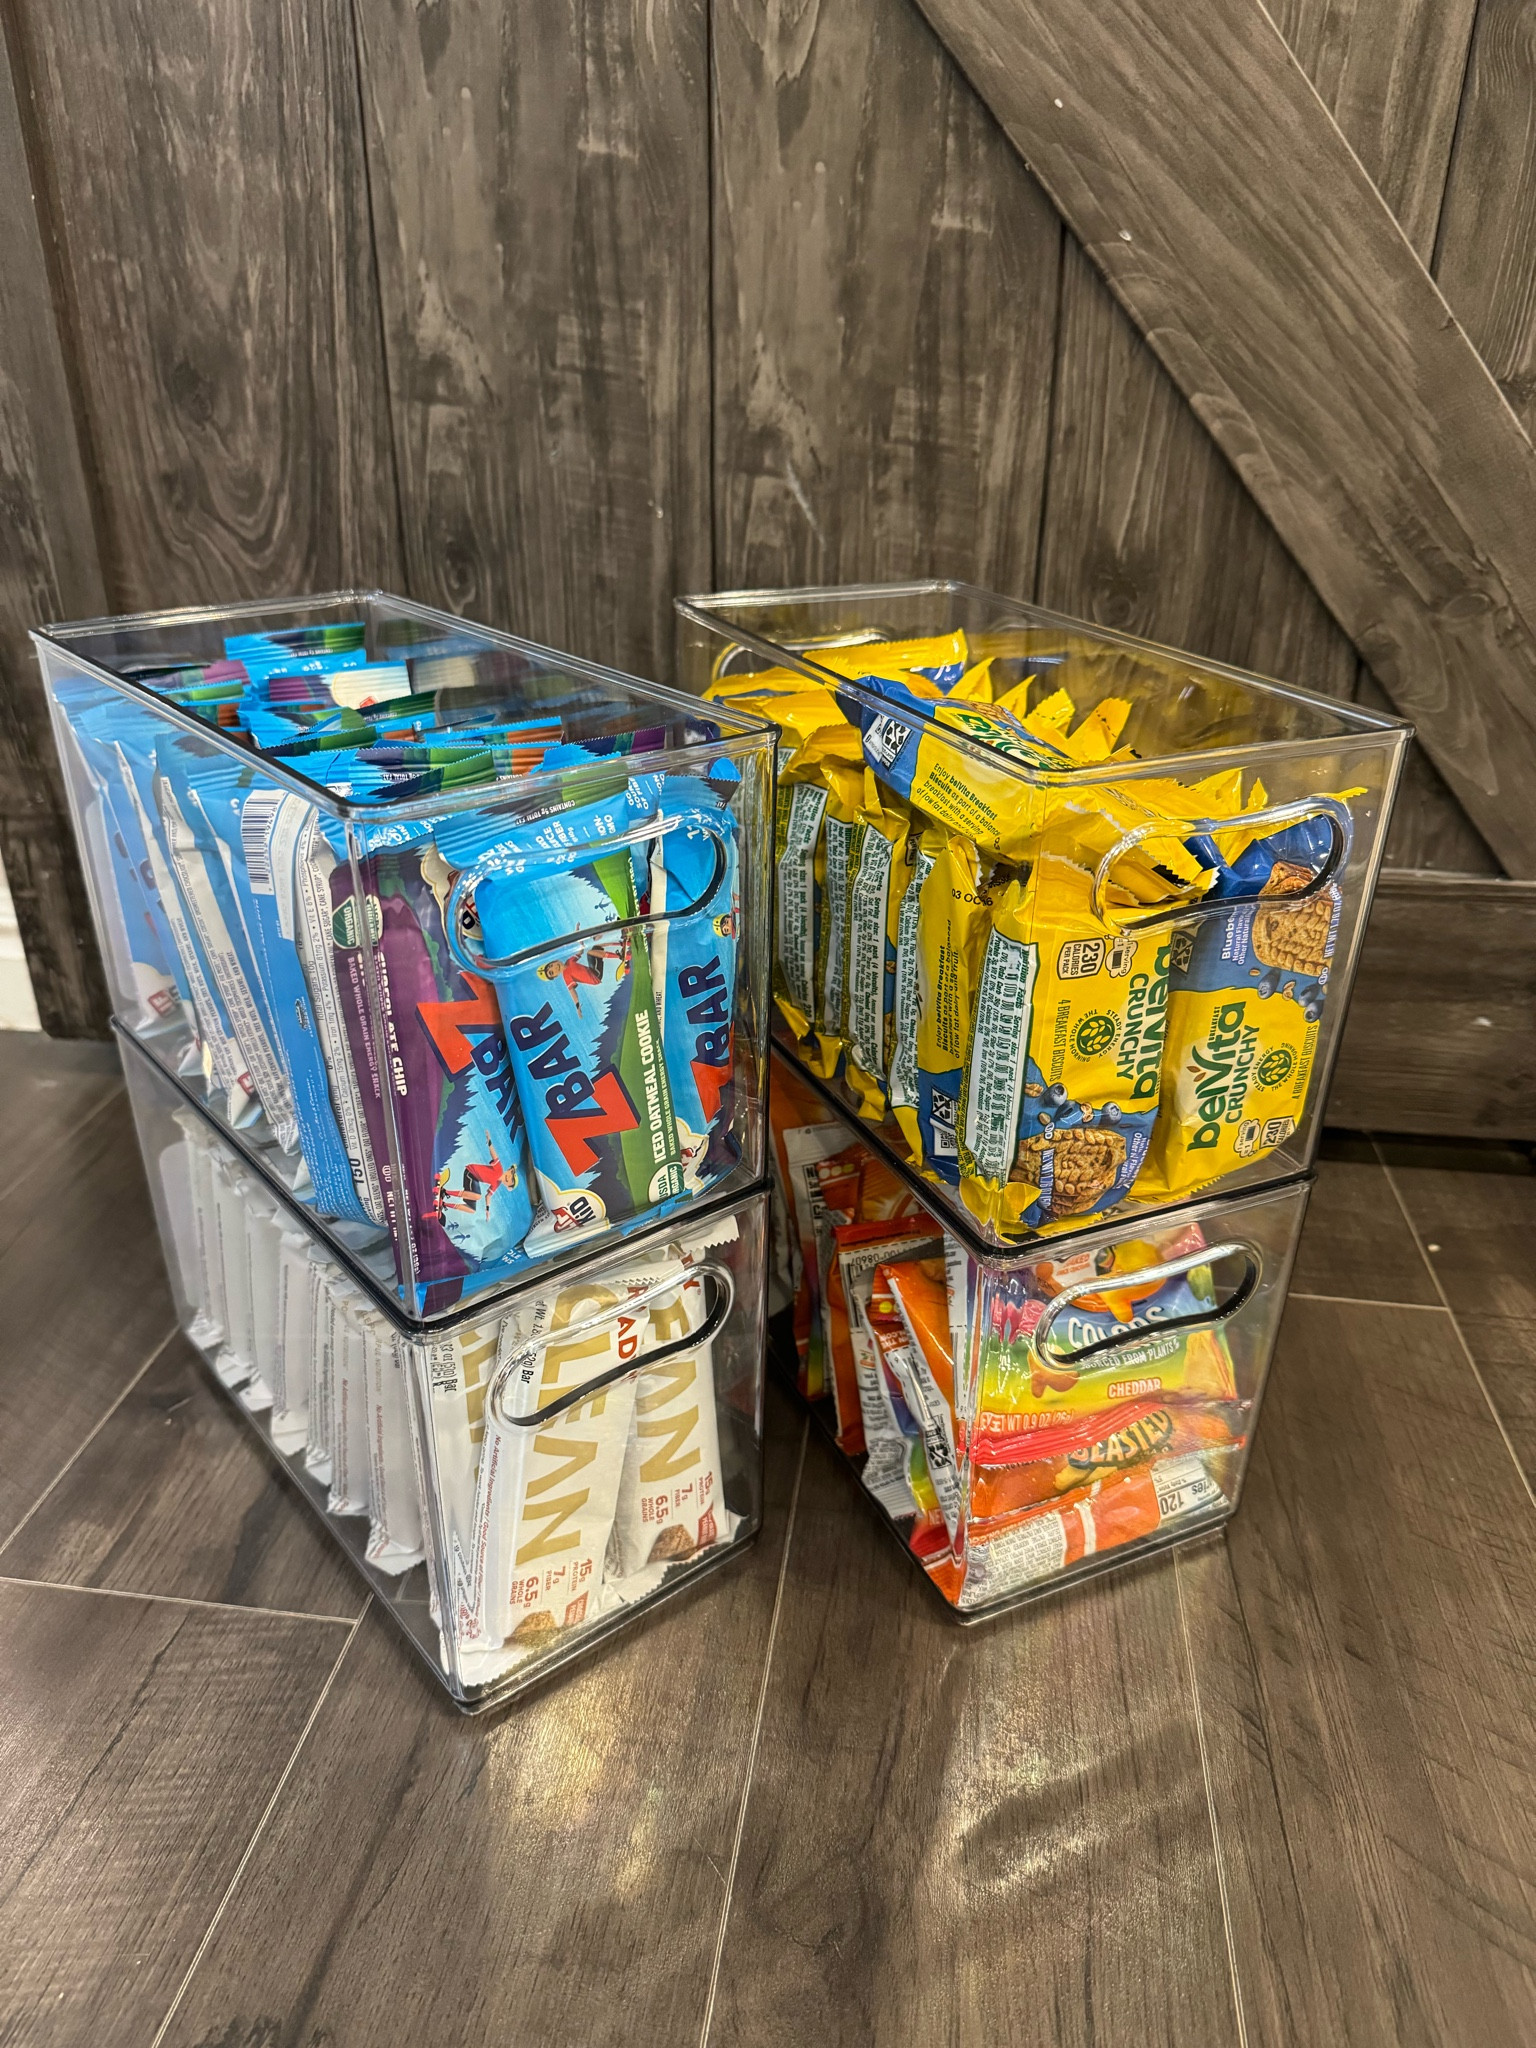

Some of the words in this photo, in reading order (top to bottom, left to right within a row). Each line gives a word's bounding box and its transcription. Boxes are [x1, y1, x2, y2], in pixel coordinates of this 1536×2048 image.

[916, 787, 926, 796] of
[922, 792, 933, 805] low
[931, 800, 943, 812] fat
[929, 771, 953, 795] Biscuits
[951, 791, 959, 800] as
[957, 797, 971, 811] part
[969, 808, 978, 817] of
[933, 763, 950, 781] Enjoy
[949, 775, 971, 798] belVita
[969, 793, 998, 821] Breakfast
[549, 800, 576, 813] CONTAINS
[923, 780, 951, 807] breakfast
[948, 802, 961, 816] with
[963, 817, 984, 836] serving
[873, 896, 882, 919] Serving
[1064, 946, 1072, 958] PER
[1070, 943, 1082, 976] CALORIES
[1080, 942, 1101, 974] 230
[1121, 946, 1131, 974] serving
[1232, 934, 1241, 961] Natural
[1237, 945, 1248, 965] Other
[1323, 942, 1335, 958] NET
[317, 962, 328, 992] Potassium
[936, 945, 945, 990] Breakfast
[1062, 959, 1070, 974] PACK
[310, 977, 321, 1003] Sugars
[1016, 988, 1026, 1010] Facts
[347, 956, 359, 984] BAKED
[353, 984, 365, 1016] WHOLE
[359, 1015, 370, 1041] GRAIN
[365, 1041, 376, 1072] ENERGY
[943, 1005, 948, 1015] as
[1084, 1009, 1099, 1019] THE
[1106, 1009, 1122, 1030] STEADY
[1012, 1015, 1022, 1039] Serving
[1054, 1005, 1071, 1048] BREAKFAST
[1069, 1018, 1084, 1042] WHOLE
[1116, 973, 1149, 1081] CRUNCHY
[1209, 1006, 1221, 1042] BREAKFAST
[635, 1009, 654, 1067] COOKIE
[1010, 1042, 1018, 1057] size:
[1098, 1033, 1121, 1058] ENERGY
[954, 1050, 960, 1059] of
[1050, 1049, 1066, 1081] BISCUITS
[1069, 1043, 1091, 1063] MORNING
[1252, 1046, 1273, 1070] ENERGY
[1292, 1056, 1310, 1094] BREAKFAST
[1301, 1024, 1318, 1056] BISCUITS
[336, 1059, 346, 1075] 15mg
[392, 1056, 408, 1097] CHIP
[1186, 1001, 1246, 1152] belVita
[1224, 1025, 1260, 1124] CRUNCHY
[1282, 1061, 1298, 1083] WHOLE
[339, 1075, 348, 1099] Calcium
[510, 1001, 641, 1177] ZBAR
[1250, 1071, 1265, 1092] STEADY
[642, 1064, 662, 1131] OATMEAL
[660, 1086, 671, 1108] GRAIN
[663, 1109, 674, 1133] WHOLE
[1238, 1121, 1250, 1146] serving
[1264, 1121, 1282, 1145] 230
[652, 1131, 667, 1164] ICED
[666, 1133, 676, 1156] BAKED
[349, 1158, 365, 1185] 150
[521, 1369, 535, 1384] Bar
[1109, 1378, 1161, 1398] CHEDDAR
[493, 1434, 502, 1445] No
[489, 1446, 500, 1477] Artificial
[484, 1477, 496, 1518] Ingredients
[641, 1497, 649, 1523] GRAINS
[647, 1497, 655, 1521] WHOLE
[655, 1495, 669, 1525] 6.5g
[1160, 1491, 1184, 1516] 120
[481, 1521, 490, 1539] Good
[479, 1540, 487, 1563] Source
[553, 1565, 567, 1584] 7g
[571, 1561, 579, 1591] PROTEIN
[579, 1558, 593, 1583] 15g
[509, 1581, 519, 1605] GRAINS
[517, 1579, 525, 1603] WHOLE
[523, 1576, 539, 1609] 6.5g
